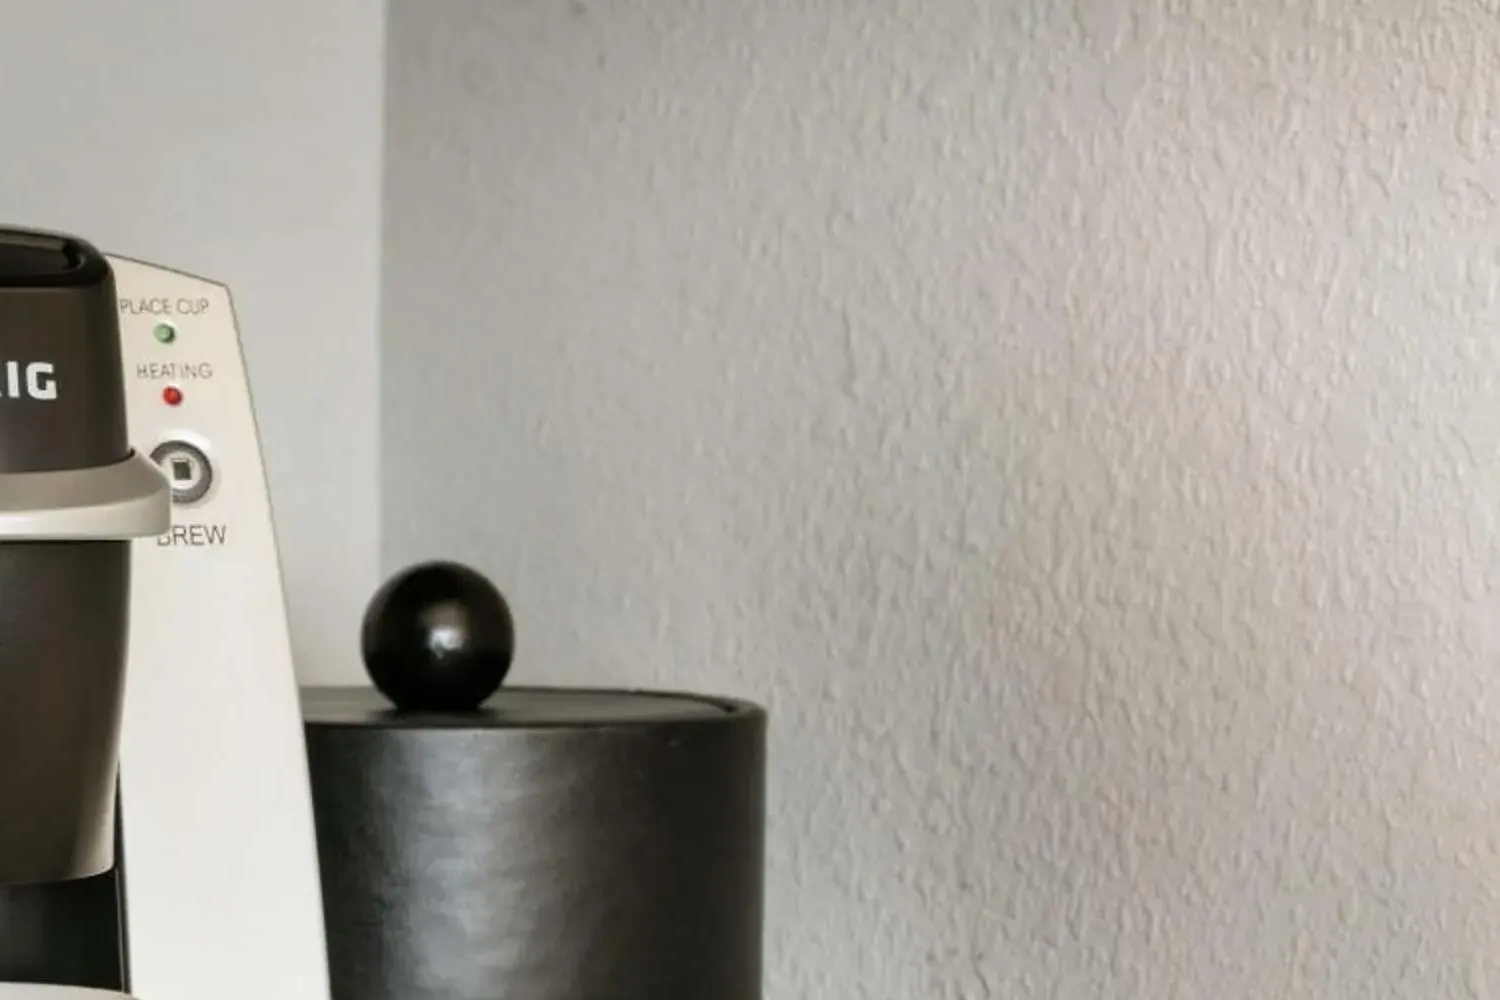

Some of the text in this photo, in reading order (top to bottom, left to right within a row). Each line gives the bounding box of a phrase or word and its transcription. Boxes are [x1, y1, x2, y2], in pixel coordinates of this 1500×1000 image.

[120, 298, 209, 315] PLACE CUP
[136, 362, 213, 380] HEATING
